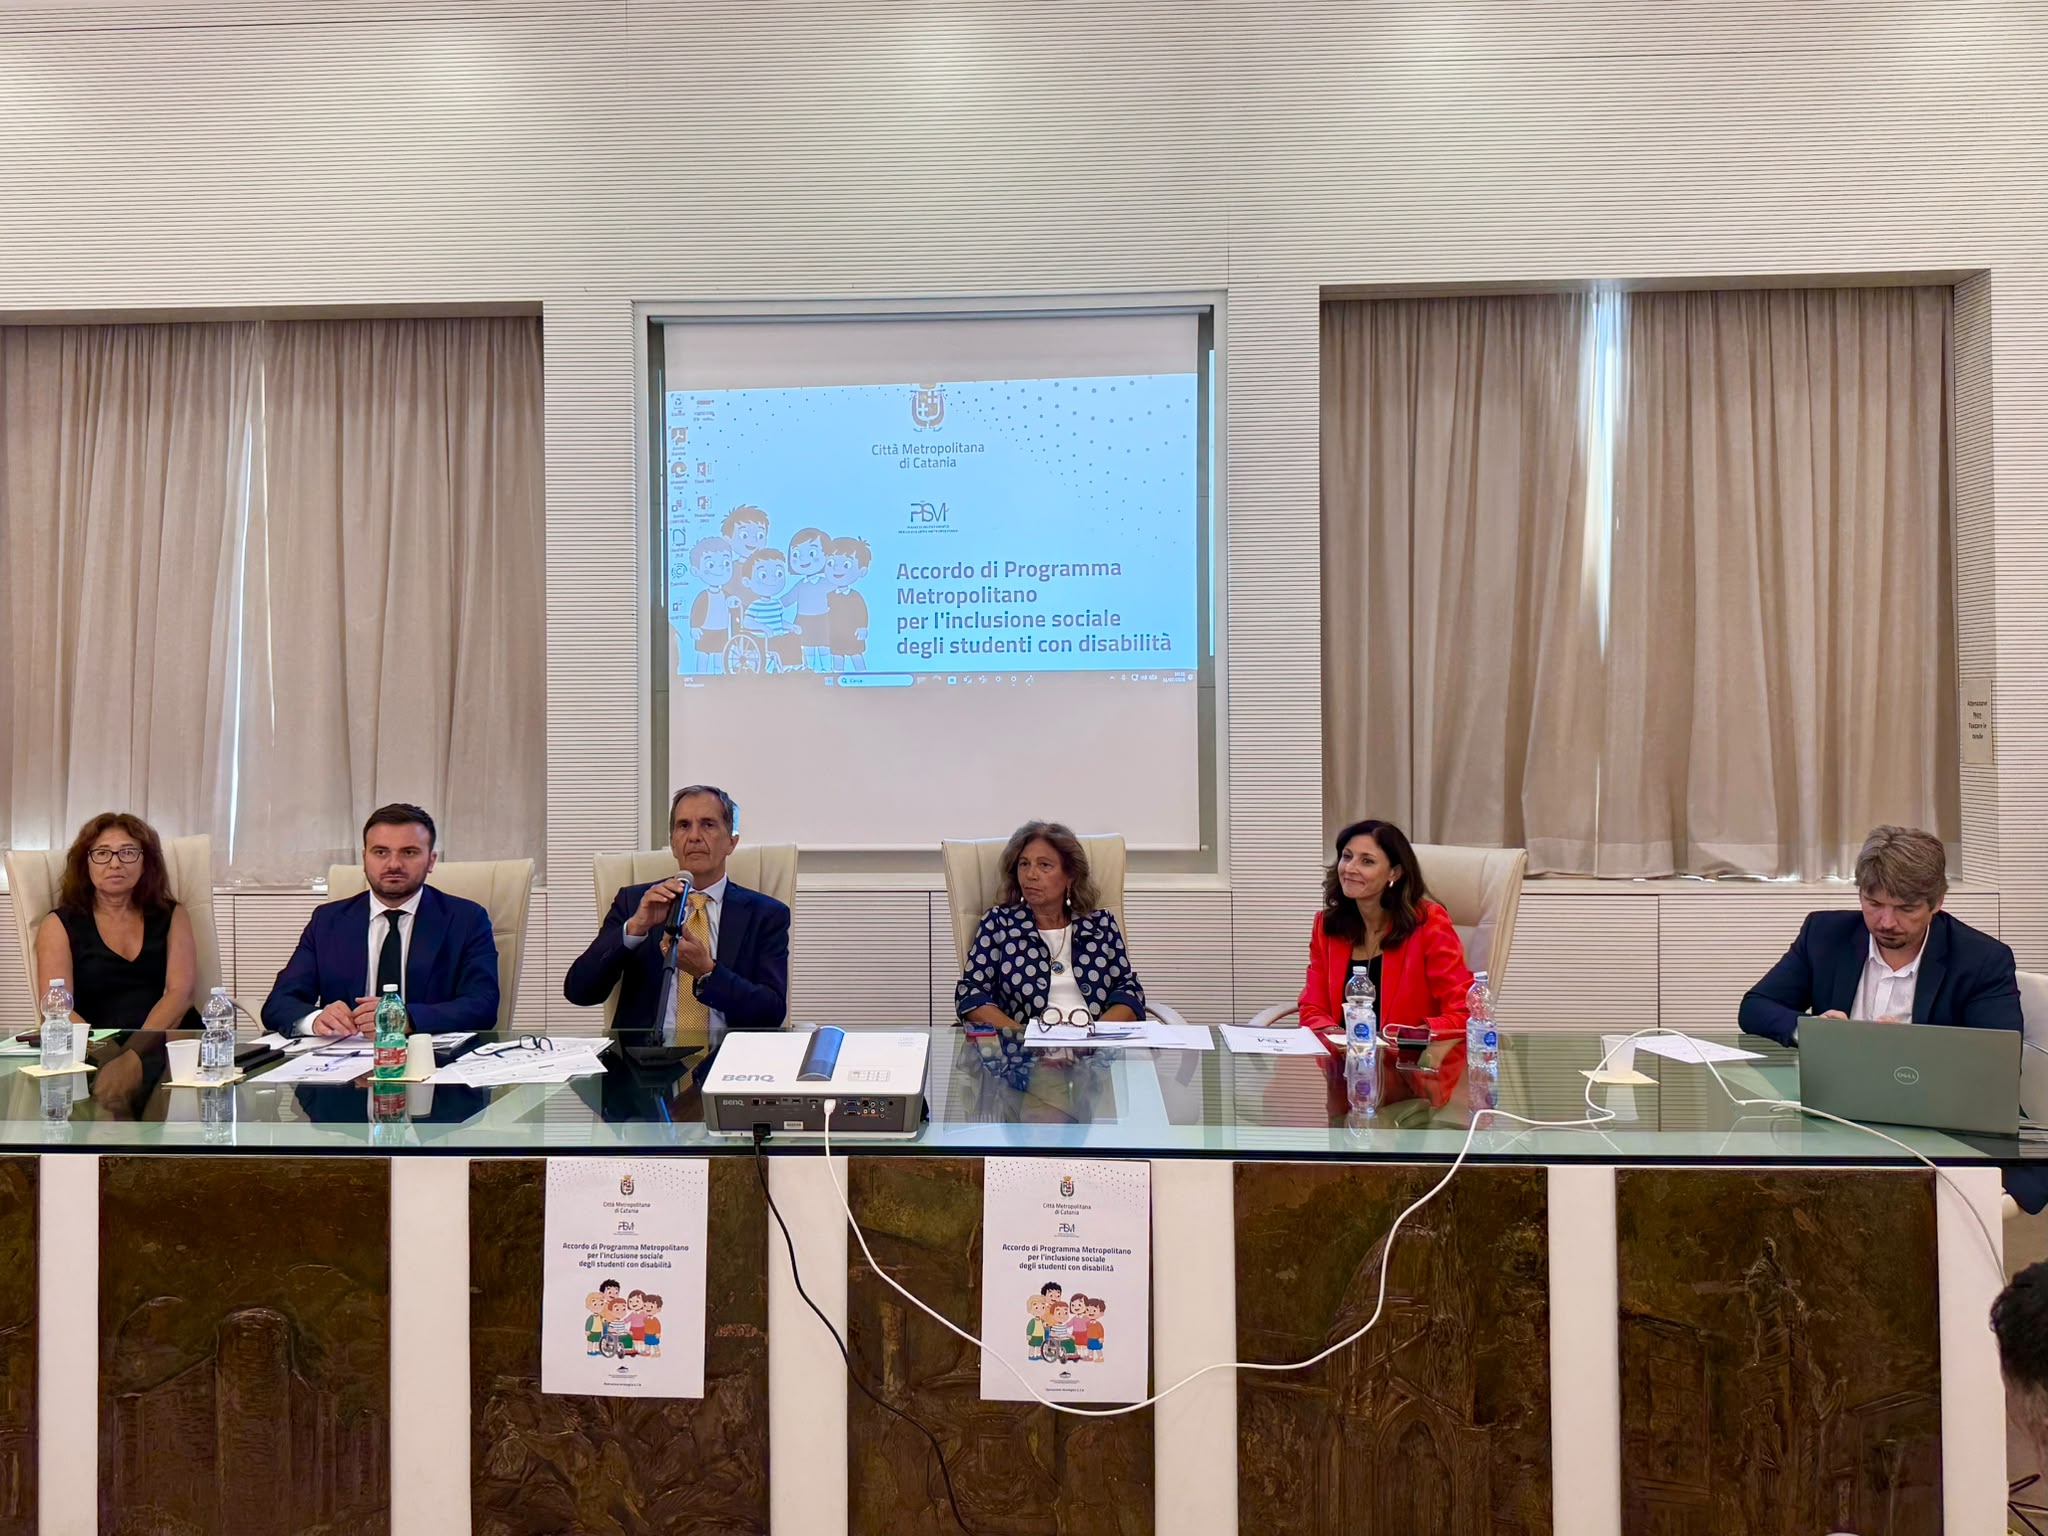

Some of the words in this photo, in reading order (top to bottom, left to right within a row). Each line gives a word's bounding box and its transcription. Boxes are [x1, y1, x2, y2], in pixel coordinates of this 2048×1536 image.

[872, 444, 899, 456] Città
[902, 442, 985, 457] Metropolitana
[900, 458, 910, 469] di
[913, 456, 957, 469] Catania
[896, 562, 975, 580] Accordo
[980, 560, 998, 578] di
[1005, 560, 1122, 582] Programma
[898, 586, 1038, 608] Metropolitano
[897, 616, 928, 634] per
[935, 610, 1046, 629] l'inclusione
[1052, 609, 1121, 628] sociale
[897, 637, 944, 659] degli
[950, 636, 1032, 654] studenti
[1038, 640, 1072, 652] con
[1078, 632, 1172, 652] disabilità
[722, 1074, 775, 1082] BenQ
[599, 1244, 639, 1252] Programma
[640, 1244, 689, 1252] Metropolitano
[1040, 1245, 1080, 1254] Programma
[1082, 1246, 1131, 1255] Metropolitano
[579, 1261, 595, 1269] degli
[1019, 1263, 1036, 1271] degli
